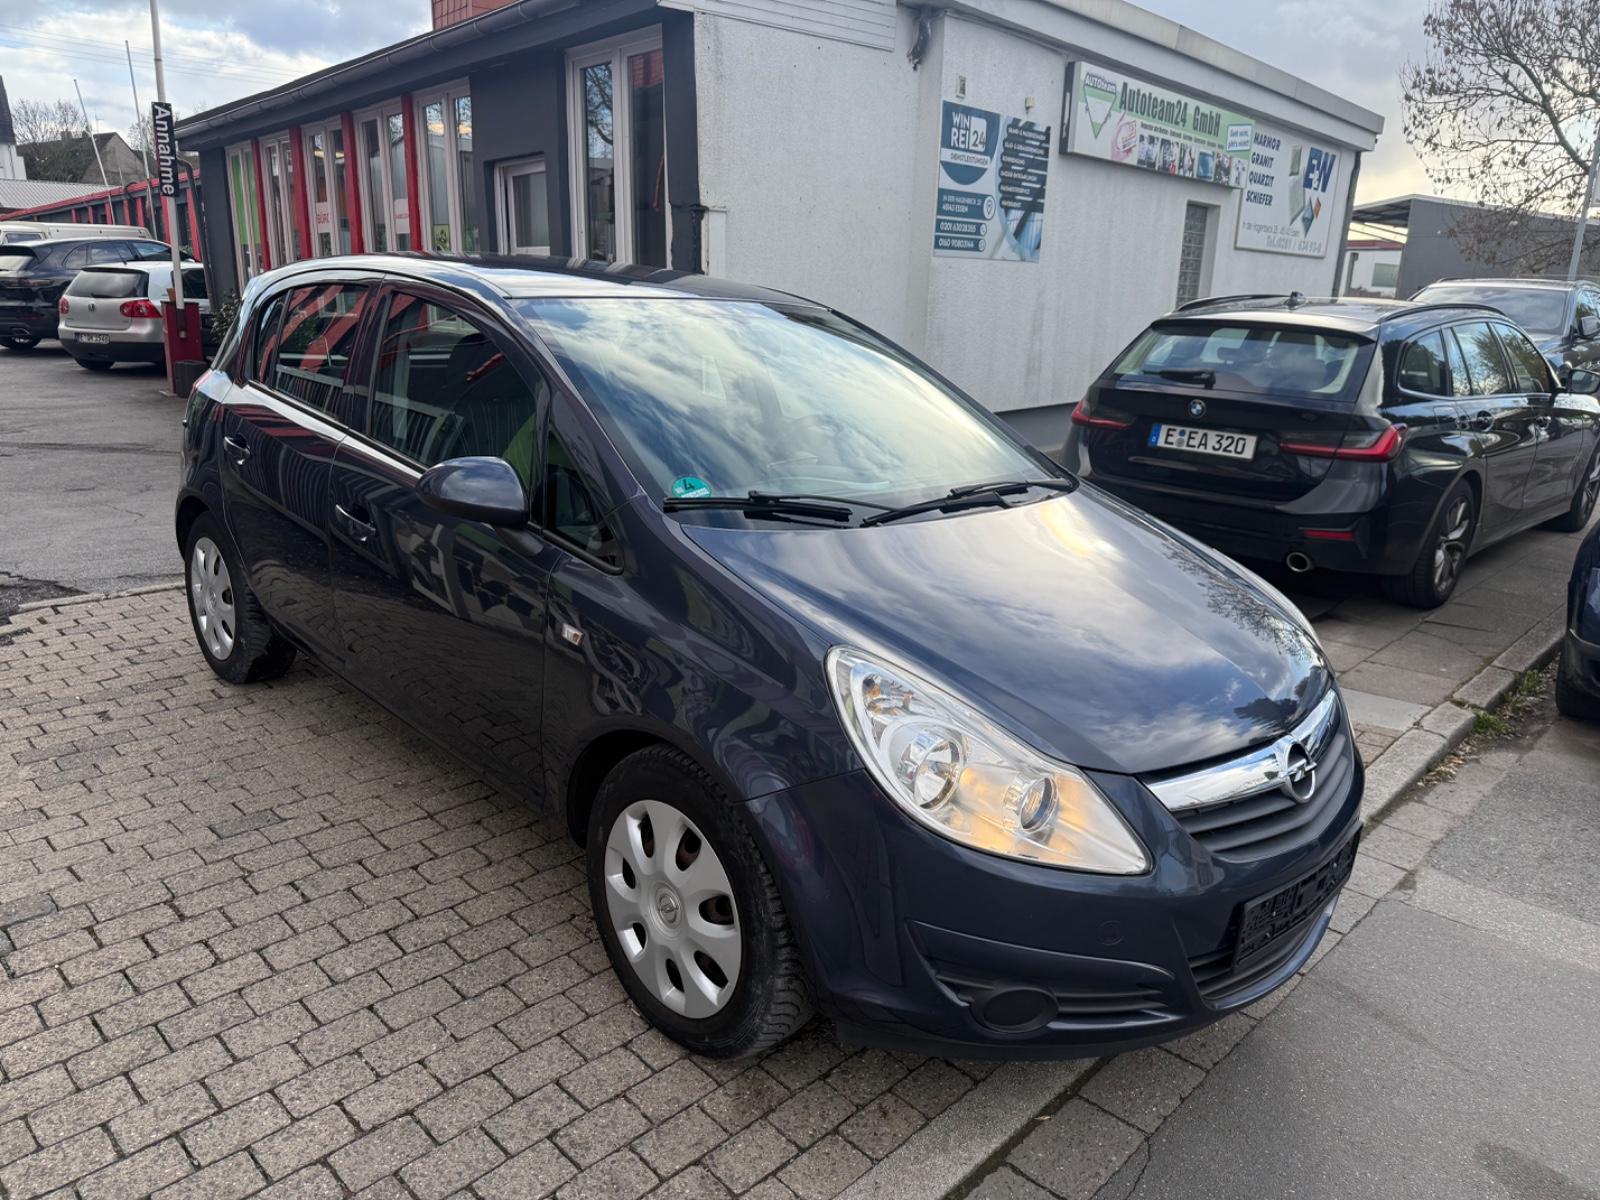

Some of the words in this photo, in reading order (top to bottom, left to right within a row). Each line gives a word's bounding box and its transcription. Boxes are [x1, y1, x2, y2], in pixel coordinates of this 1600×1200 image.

[1119, 82, 1188, 128] Autoteam24
[1192, 105, 1222, 138] GmbH
[952, 111, 970, 129] WIN
[951, 127, 969, 150] REI
[971, 130, 986, 149] 24
[1253, 132, 1281, 151] MARMOR
[154, 105, 176, 195] Annahme
[1251, 151, 1274, 169] GRANIT
[1248, 171, 1275, 188] QUARZIT
[1245, 190, 1274, 207] SCHIEFER
[1164, 427, 1176, 446] E
[1186, 430, 1208, 450] EA
[1212, 433, 1246, 455] 320
